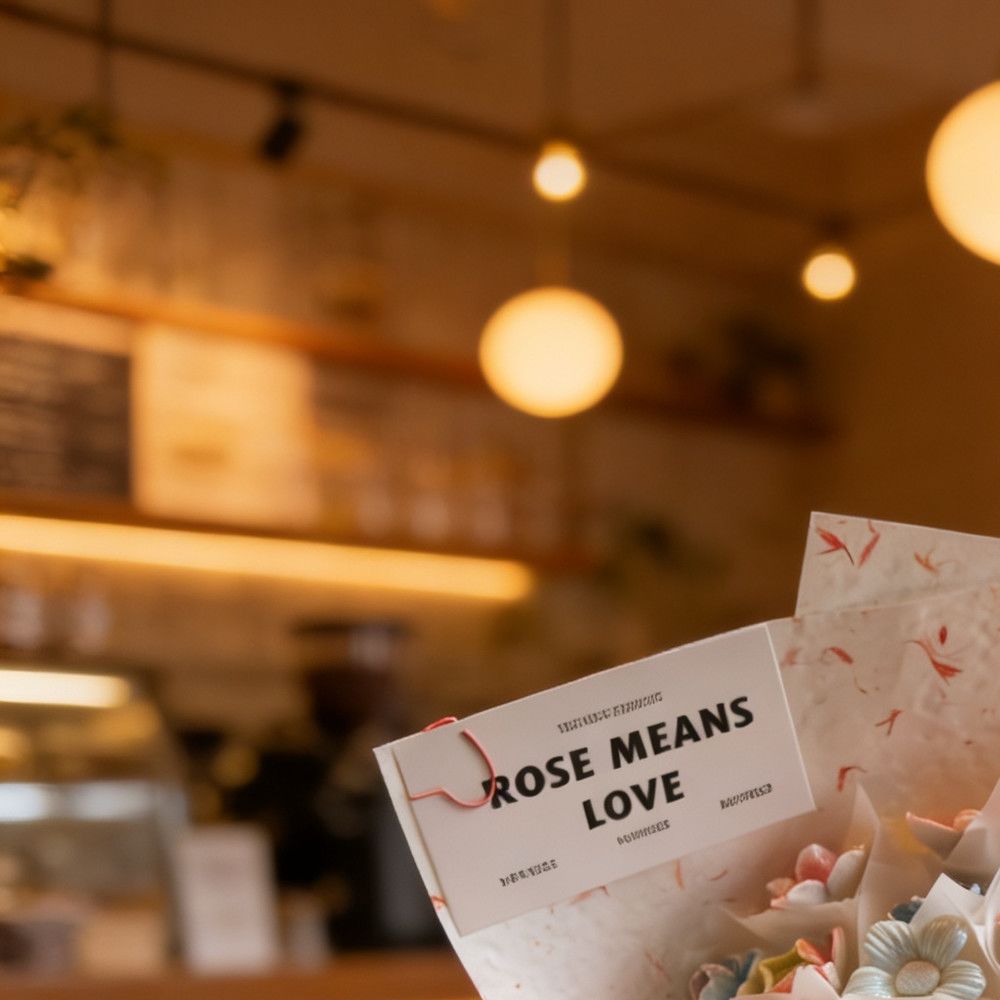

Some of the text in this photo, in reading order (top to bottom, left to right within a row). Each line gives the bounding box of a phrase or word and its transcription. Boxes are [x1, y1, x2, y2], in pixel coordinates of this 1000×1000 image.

[481, 747, 595, 809] ROSE
[609, 696, 754, 770] MEANS
[582, 770, 685, 830] LOVE
